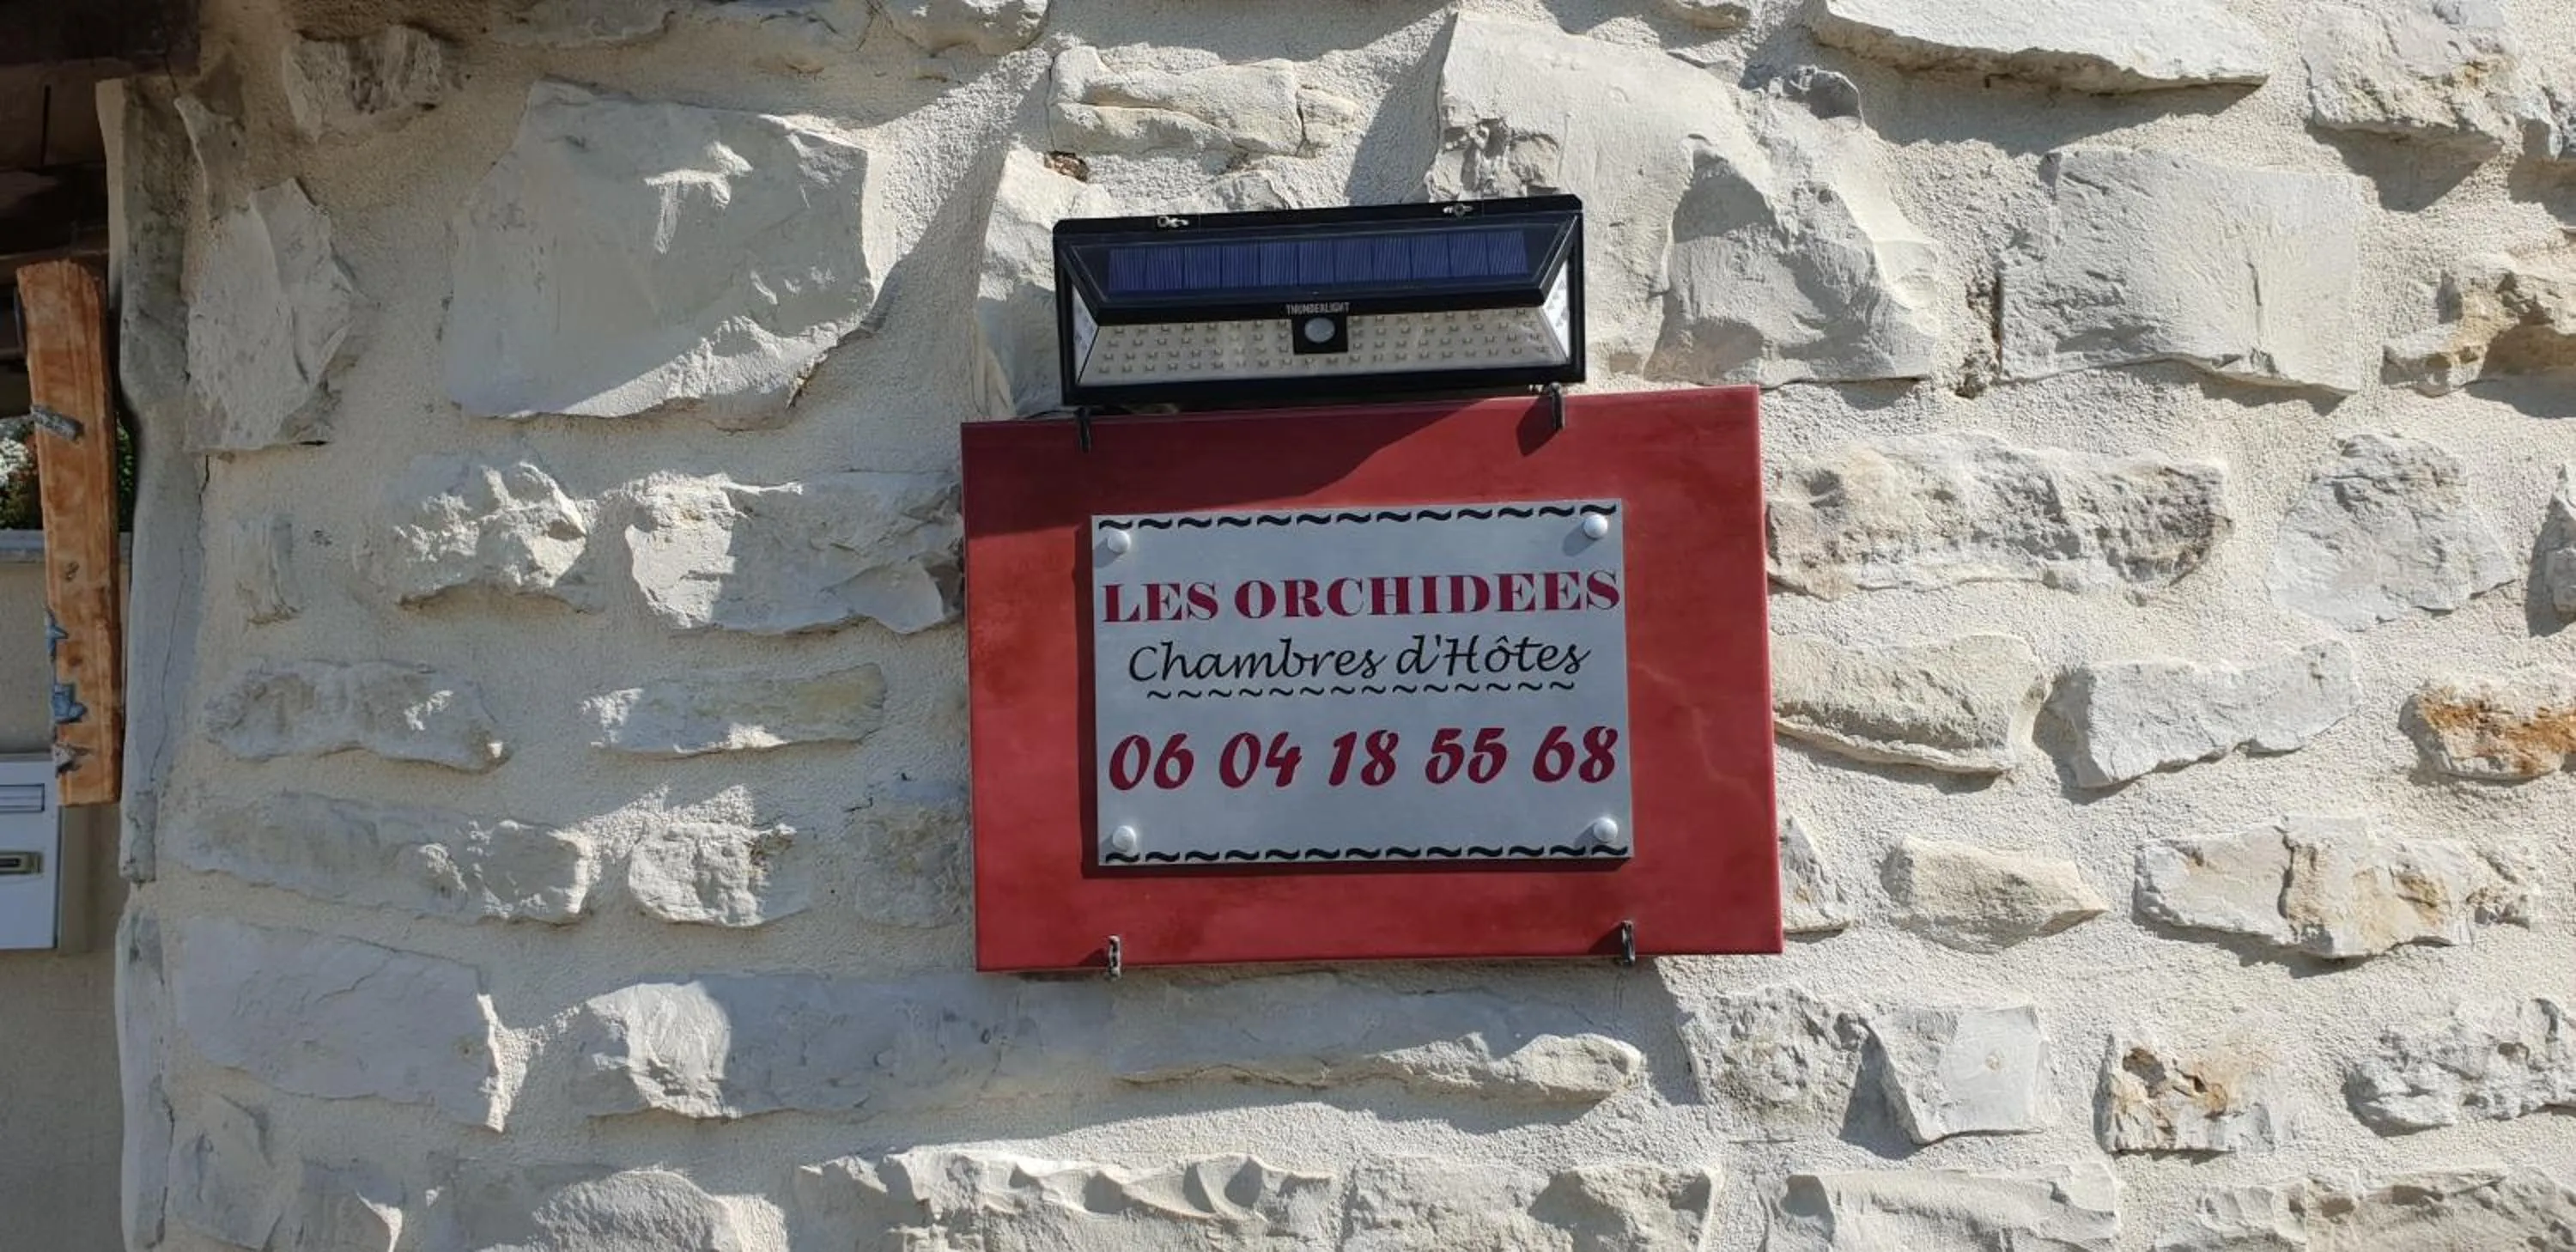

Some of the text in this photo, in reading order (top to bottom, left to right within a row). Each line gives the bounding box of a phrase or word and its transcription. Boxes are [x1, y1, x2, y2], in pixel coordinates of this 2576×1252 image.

[1286, 302, 1350, 315] THUNDERLIGHT
[1103, 569, 1621, 623] LES ORCHIDEES
[1128, 634, 1592, 682] Chambres d'Hôtes
[1109, 725, 1619, 791] 06 04 18 55 68
